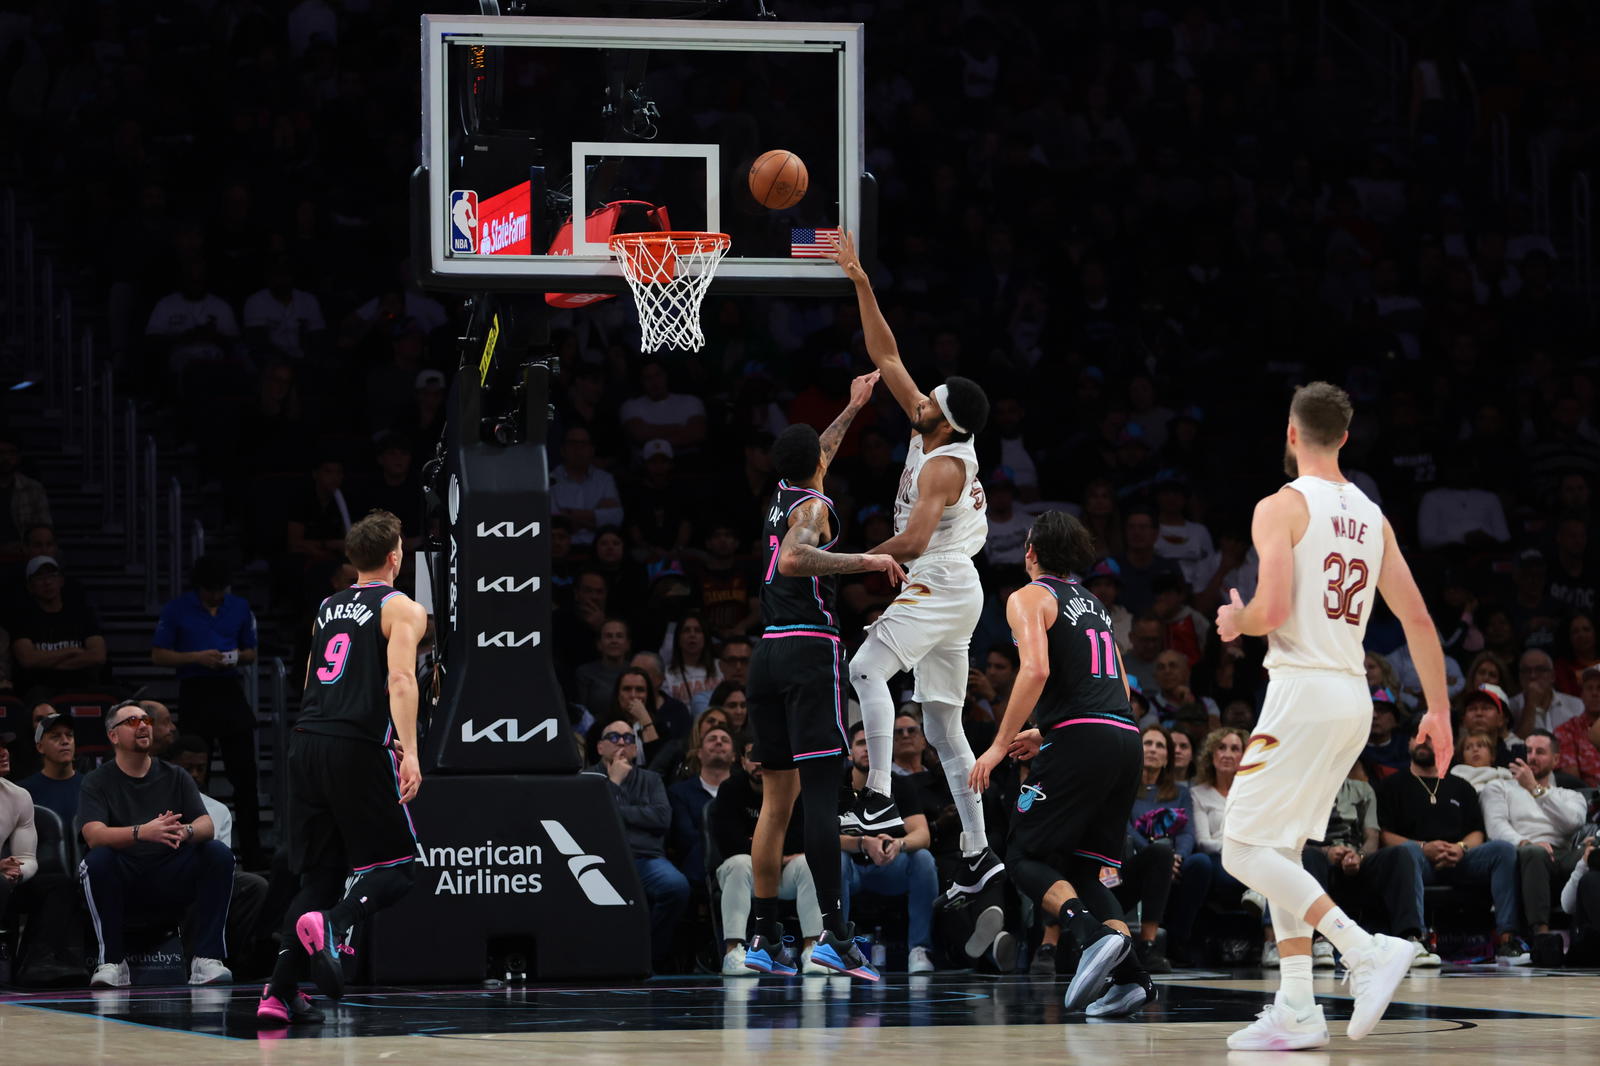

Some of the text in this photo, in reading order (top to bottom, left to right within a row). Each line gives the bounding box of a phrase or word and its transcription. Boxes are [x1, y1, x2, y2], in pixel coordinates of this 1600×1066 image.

[454, 239, 468, 249] NBA
[1331, 516, 1368, 544] WADE
[449, 533, 458, 632] AT&T
[1323, 552, 1369, 626] 32
[317, 603, 374, 629] LARSSON
[1063, 597, 1097, 626] JAQUEZ
[316, 632, 352, 684] 9
[1085, 628, 1118, 679] 11
[414, 840, 543, 867] American
[434, 869, 543, 895] Airlines
